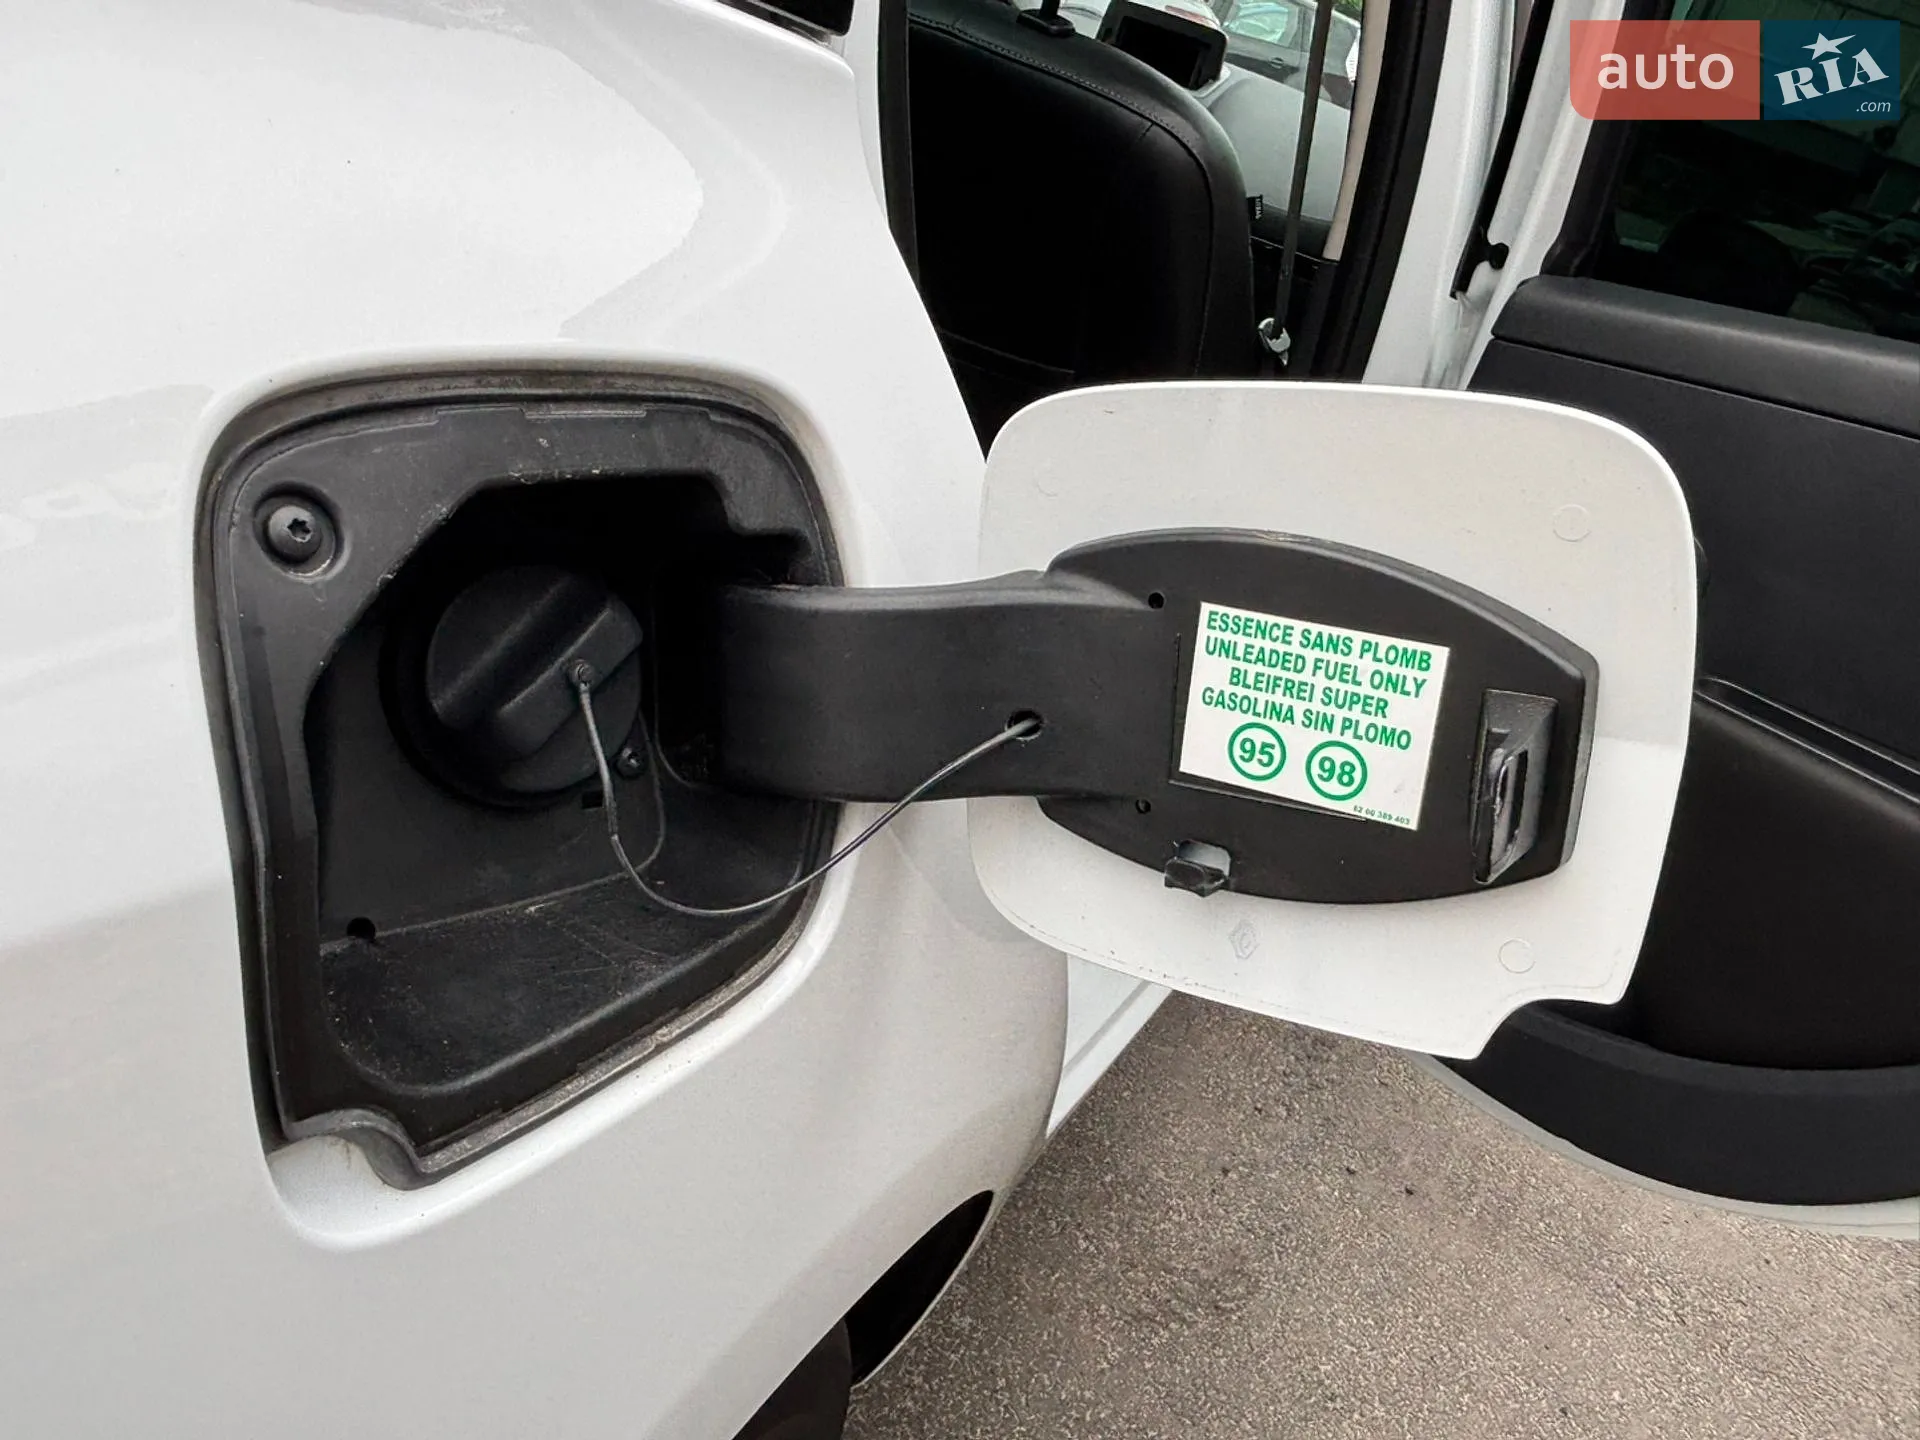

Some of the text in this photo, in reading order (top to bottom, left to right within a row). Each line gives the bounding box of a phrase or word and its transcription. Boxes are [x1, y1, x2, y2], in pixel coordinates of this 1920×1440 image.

[1205, 635, 1428, 699] UNLEADED FUEL ONLY
[1206, 610, 1433, 672] ESSENCE SANS PLOMB
[1202, 686, 1412, 751] GASOLINA SIN PLOMO
[1228, 667, 1389, 719] BLEIFREI SUPER
[1238, 737, 1357, 787] 95 98
